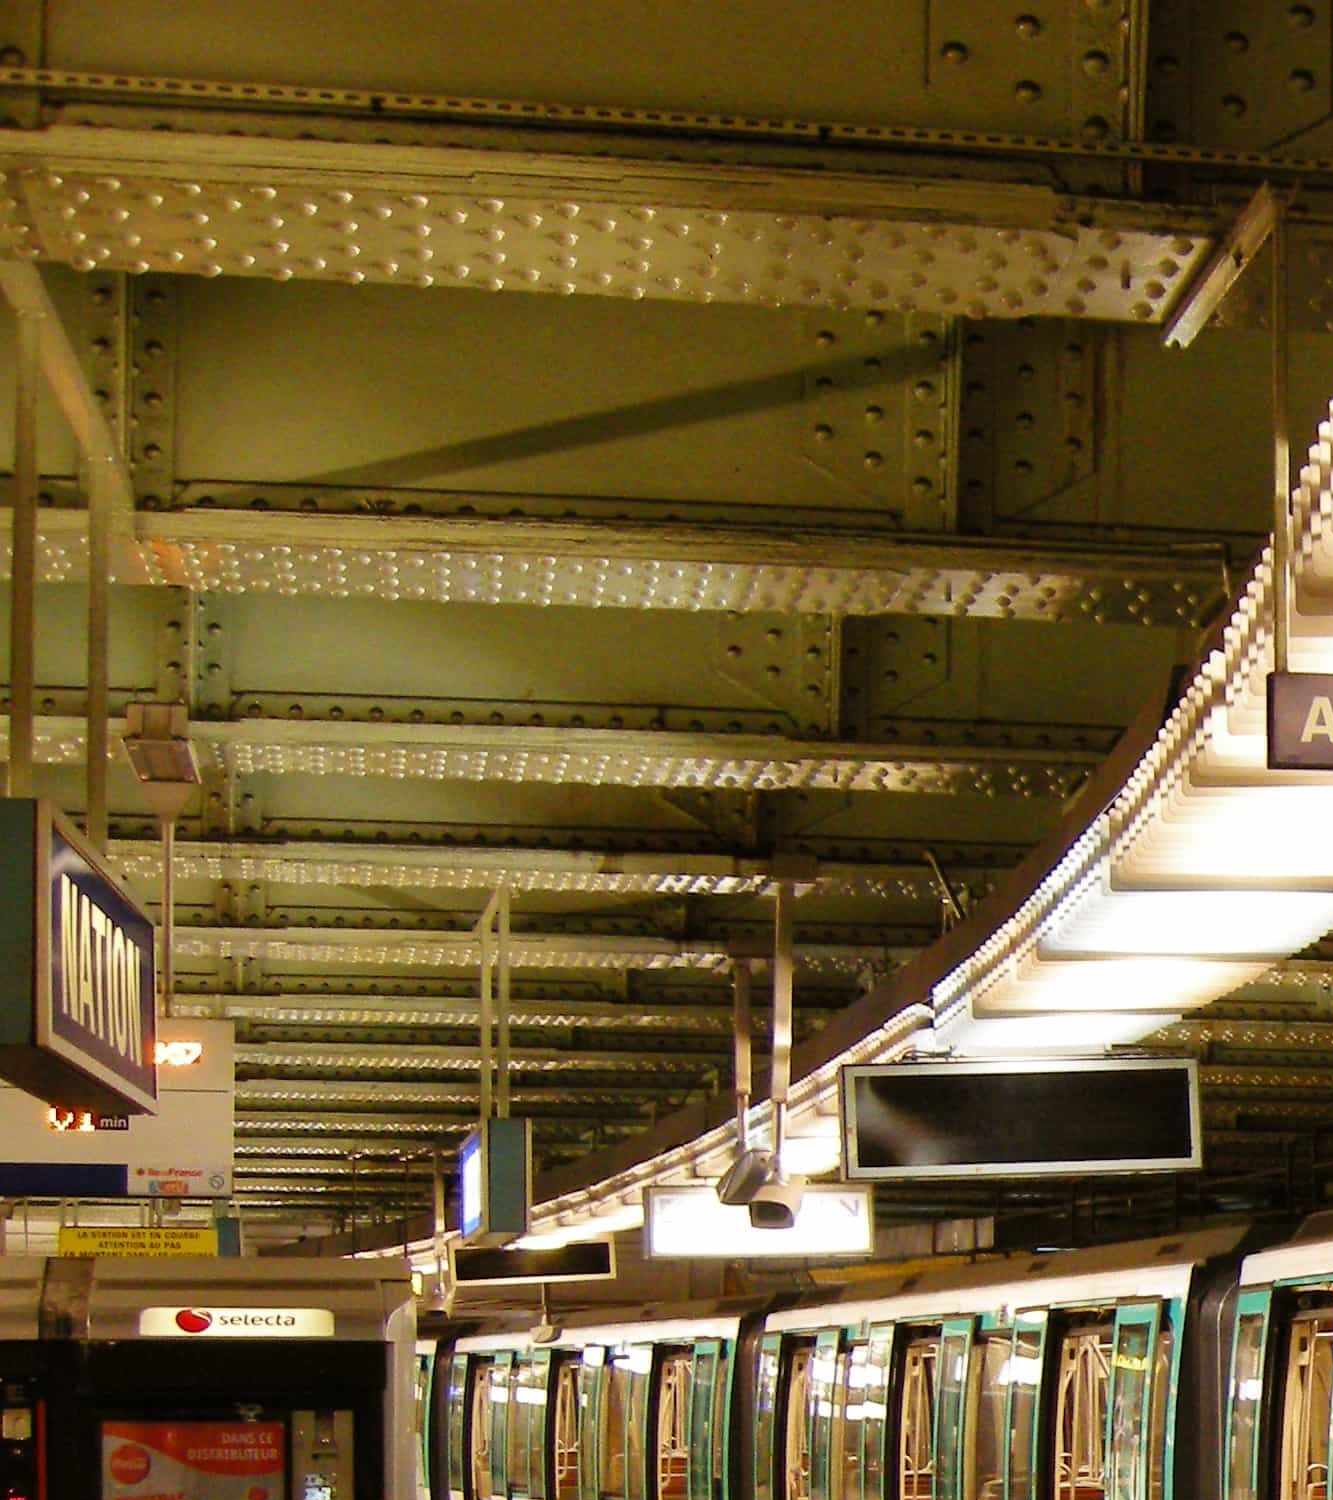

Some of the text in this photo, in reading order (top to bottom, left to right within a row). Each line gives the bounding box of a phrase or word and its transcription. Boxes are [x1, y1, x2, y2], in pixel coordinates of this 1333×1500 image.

[60, 872, 143, 1068] NATION
[100, 1118, 127, 1128] min
[90, 1231, 128, 1239] STATION
[98, 1241, 182, 1249] ATTENTION AU PAS
[218, 1314, 296, 1327] selecta
[221, 1432, 273, 1445] DANS CE
[186, 1448, 280, 1461] DISTRIBUTEUR
